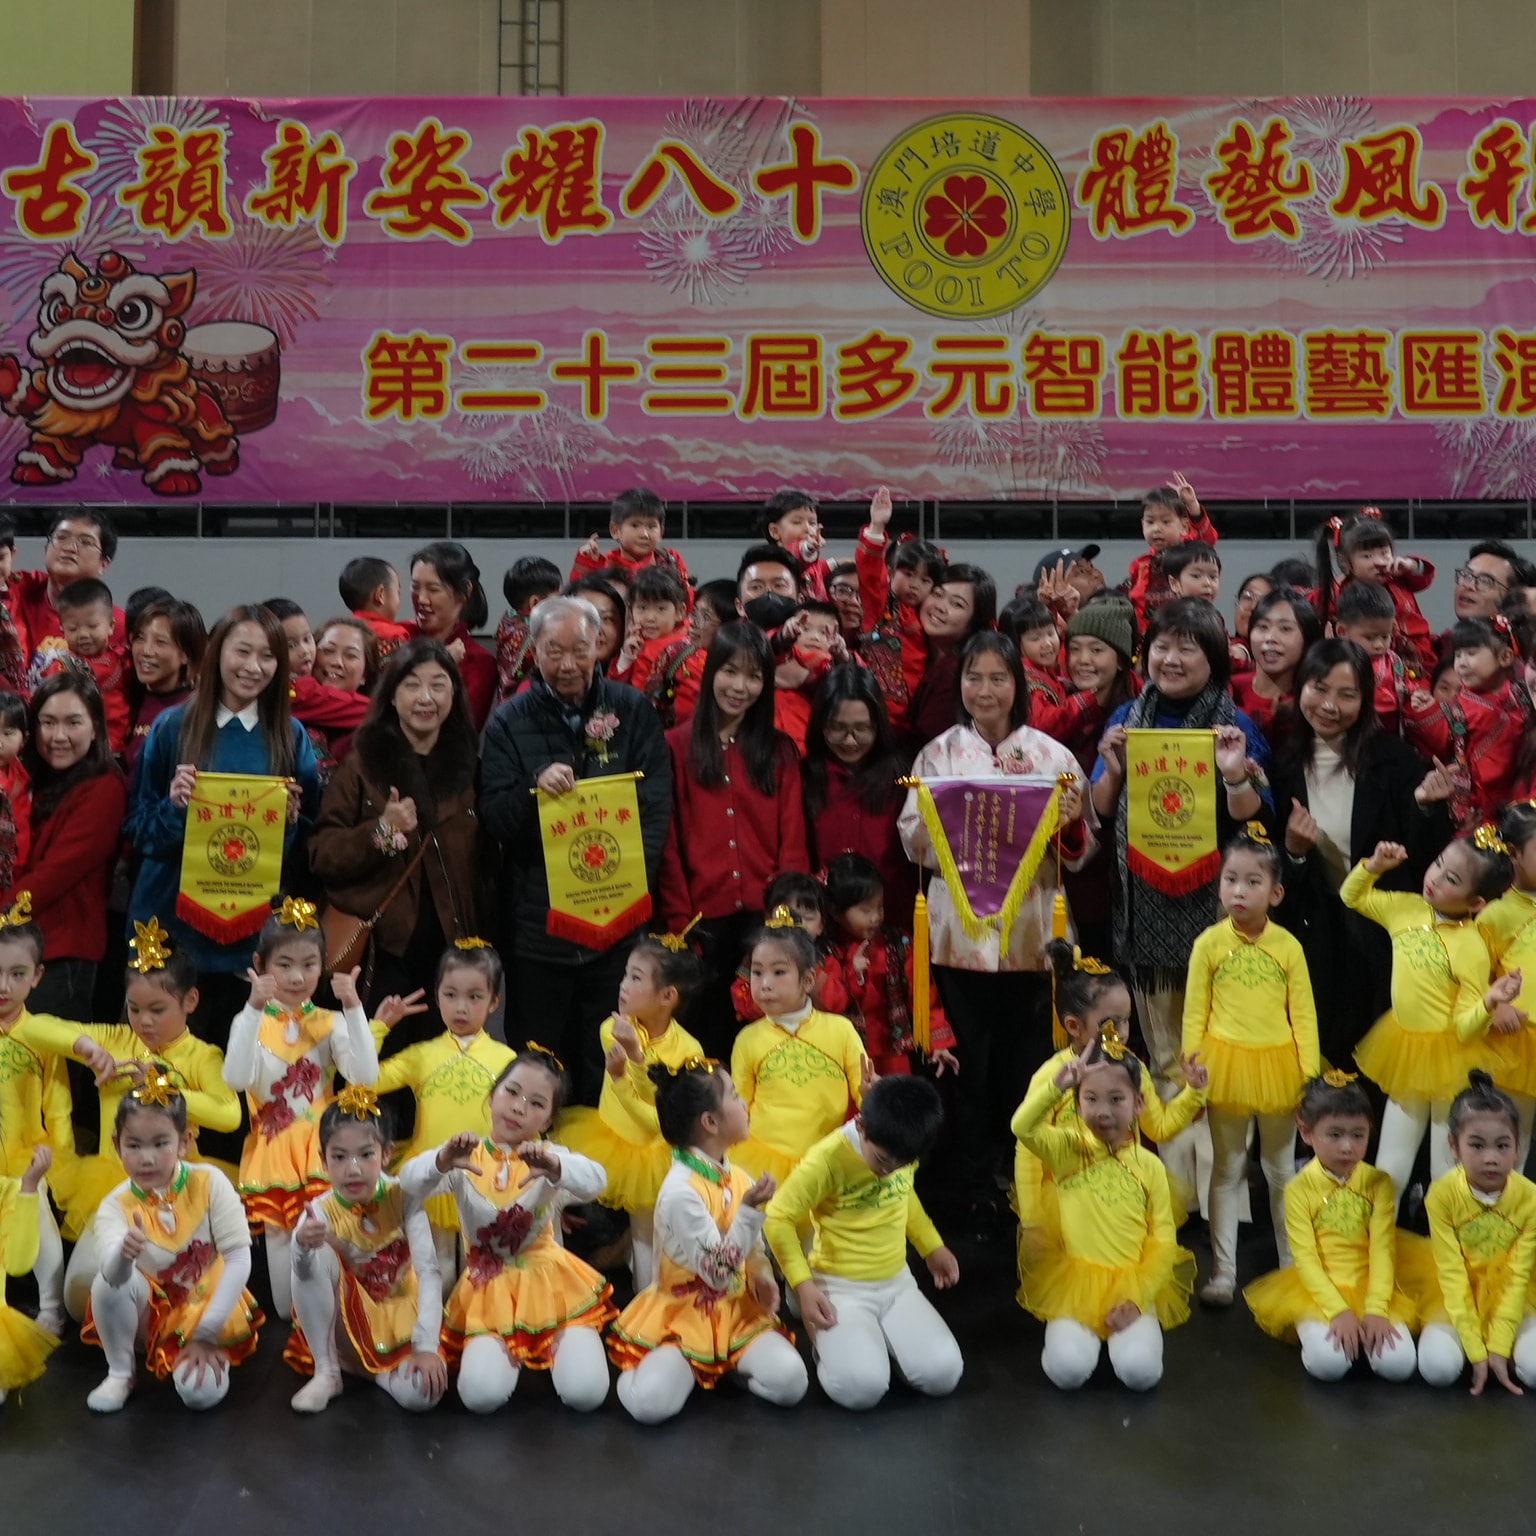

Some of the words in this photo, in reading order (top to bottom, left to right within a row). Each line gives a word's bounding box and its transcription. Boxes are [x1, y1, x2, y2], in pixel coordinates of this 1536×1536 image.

[2, 117, 858, 244] 古韻新姿耀八十
[876, 130, 1056, 218] 澳門培道中學
[880, 232, 985, 307] POOI
[997, 232, 1050, 289] TO
